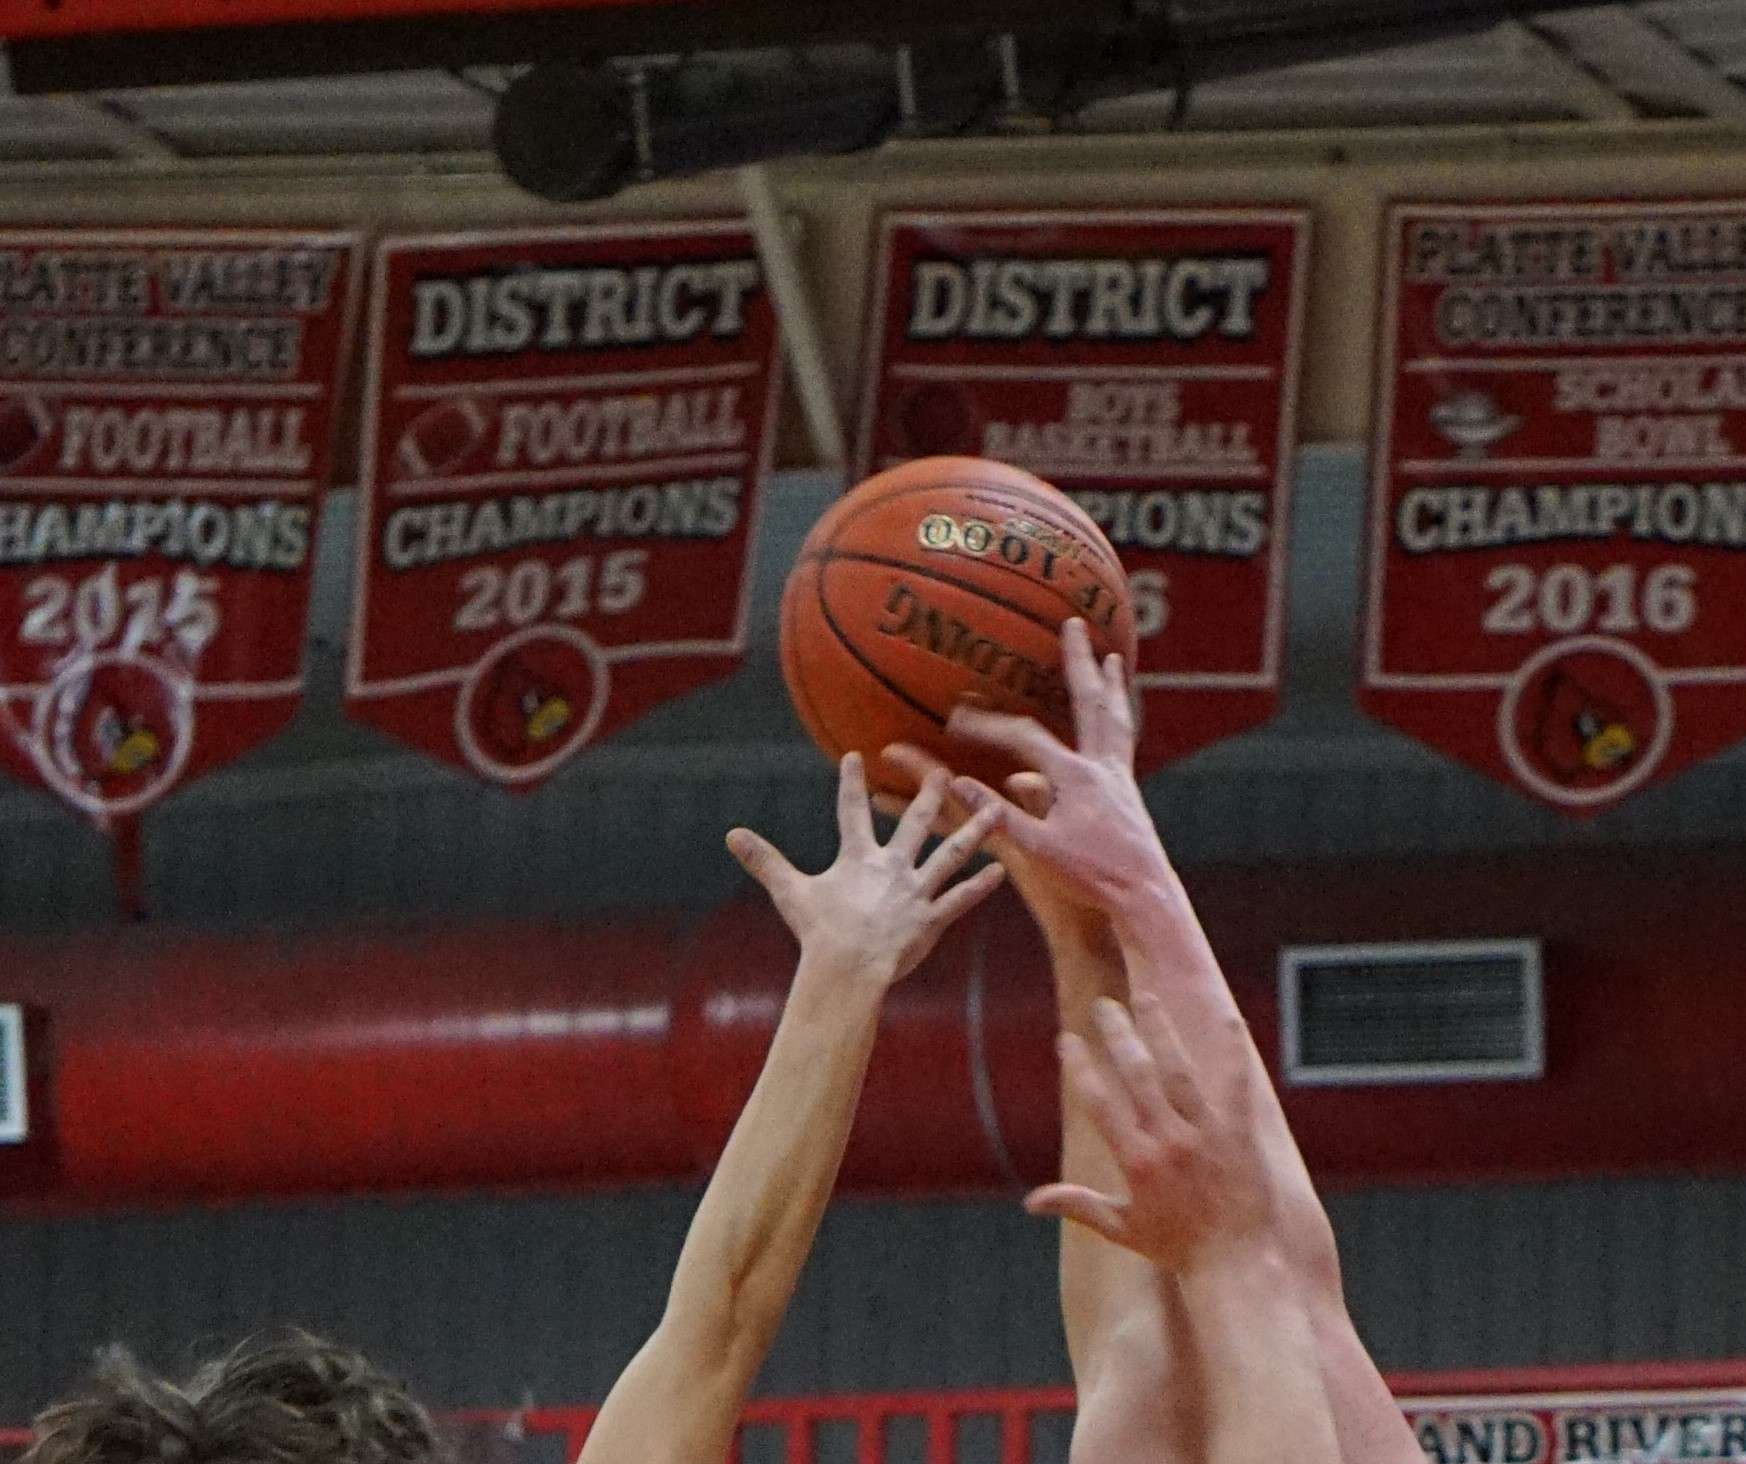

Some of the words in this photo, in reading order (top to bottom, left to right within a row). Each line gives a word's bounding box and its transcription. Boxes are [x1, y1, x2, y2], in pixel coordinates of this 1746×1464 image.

[410, 258, 762, 357] DISTRICT
[908, 257, 1271, 339] DISTRICT
[61, 404, 312, 472] FOOTBALL
[497, 388, 746, 468] FOOTBALL
[0, 500, 308, 568] HAMPIONS
[383, 476, 743, 568] CHAMPIONS
[19, 568, 222, 652] 2015
[453, 549, 650, 633] 2015
[1480, 562, 1698, 635] 2016
